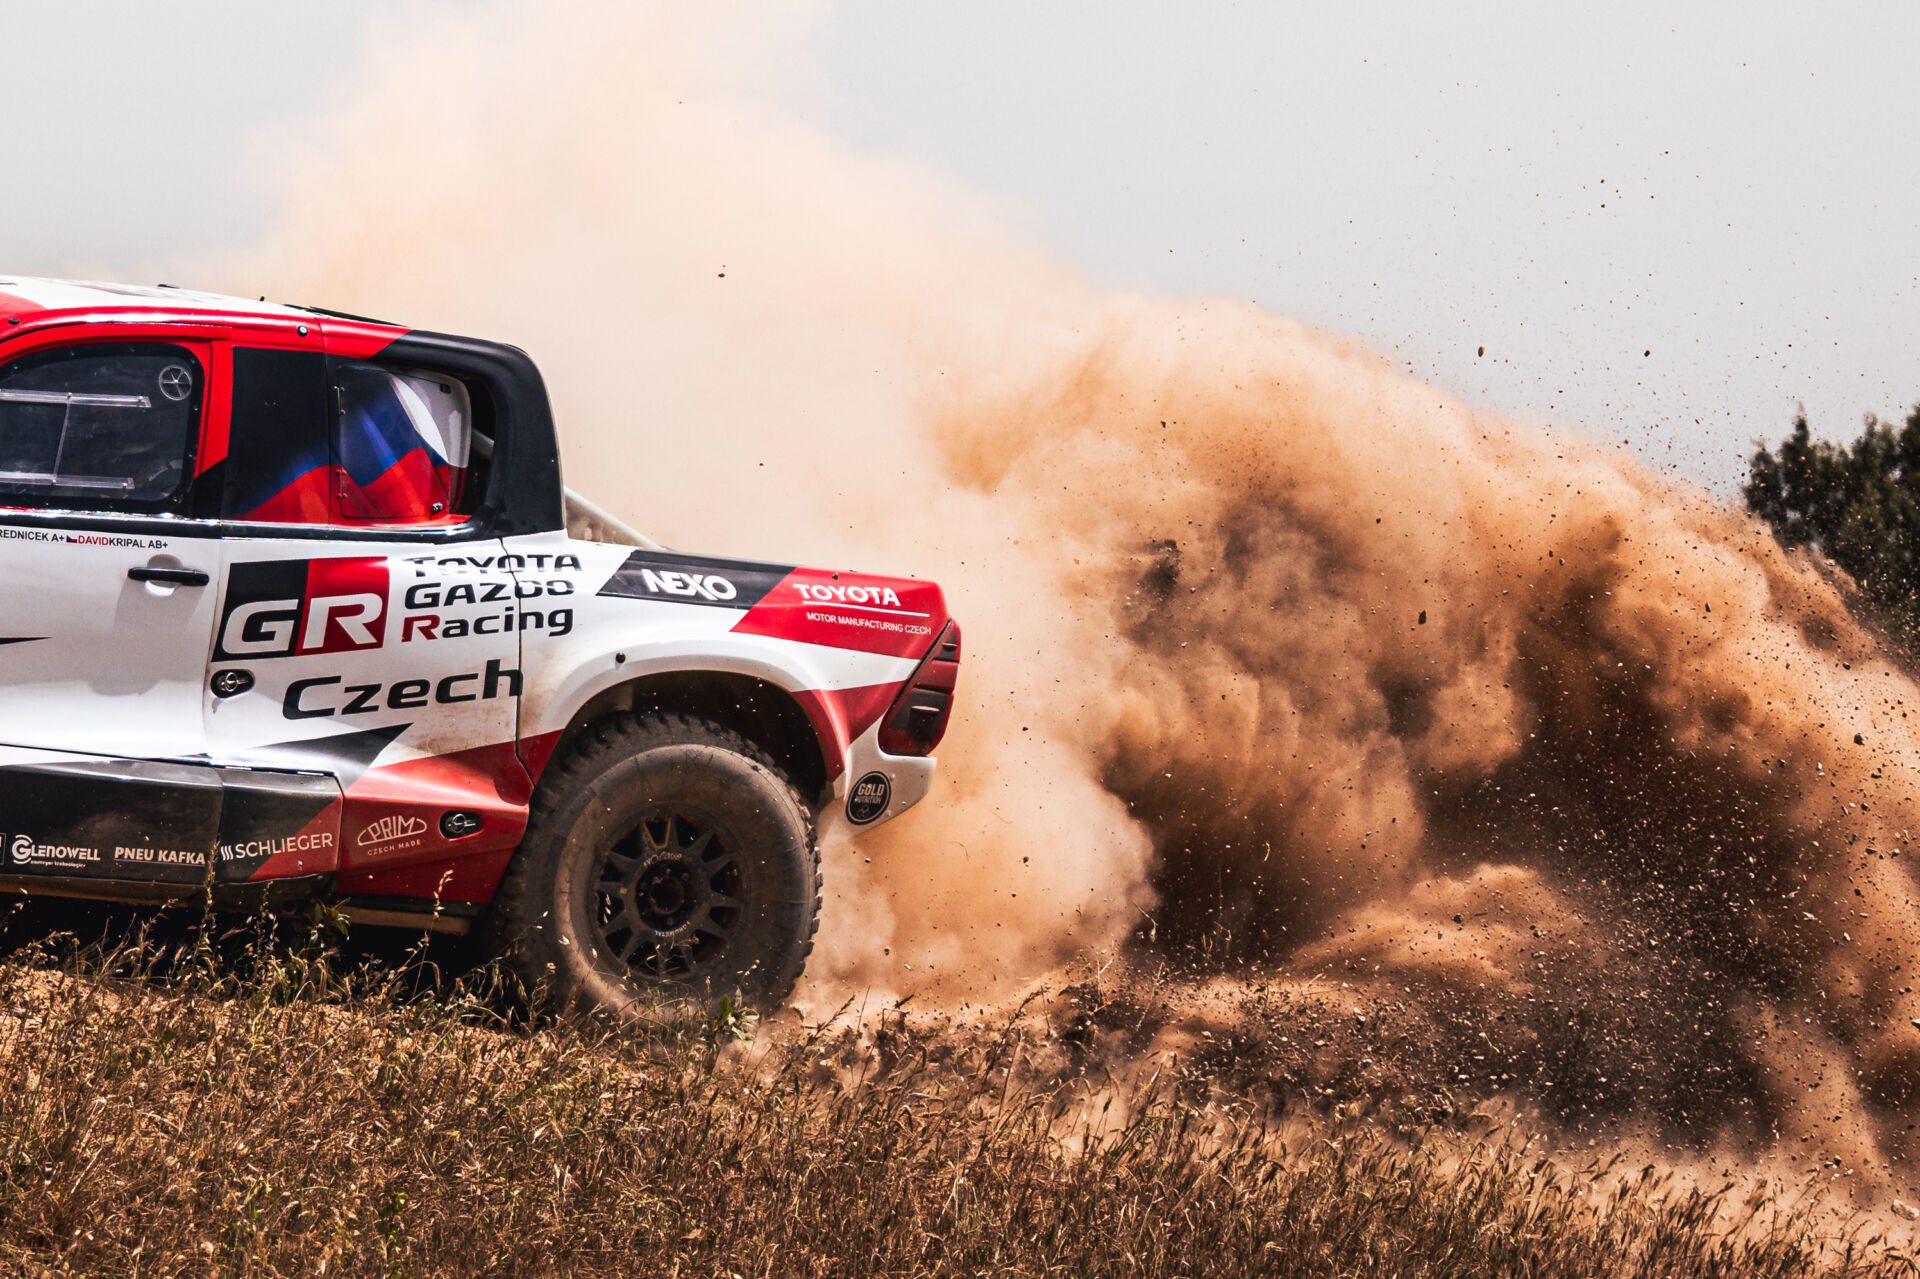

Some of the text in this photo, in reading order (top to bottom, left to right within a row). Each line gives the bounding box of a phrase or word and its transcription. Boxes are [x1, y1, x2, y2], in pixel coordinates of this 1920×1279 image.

[51, 533, 65, 542] A+
[147, 539, 169, 549] AB+
[402, 554, 583, 577] TOYOTA
[404, 580, 575, 610] GAZOO
[641, 569, 737, 601] NEXO
[793, 583, 901, 606] TOYOTA
[222, 593, 383, 654] GR
[401, 606, 573, 643] Racing
[806, 612, 932, 635] MOTOR MANUFACTURING CZECH
[282, 659, 523, 720] Czech
[367, 815, 416, 841] PRIM
[114, 846, 206, 865] PNEU KAFKA
[235, 832, 334, 859] SCHLIEGER
[367, 839, 421, 856] CZECH MADE
